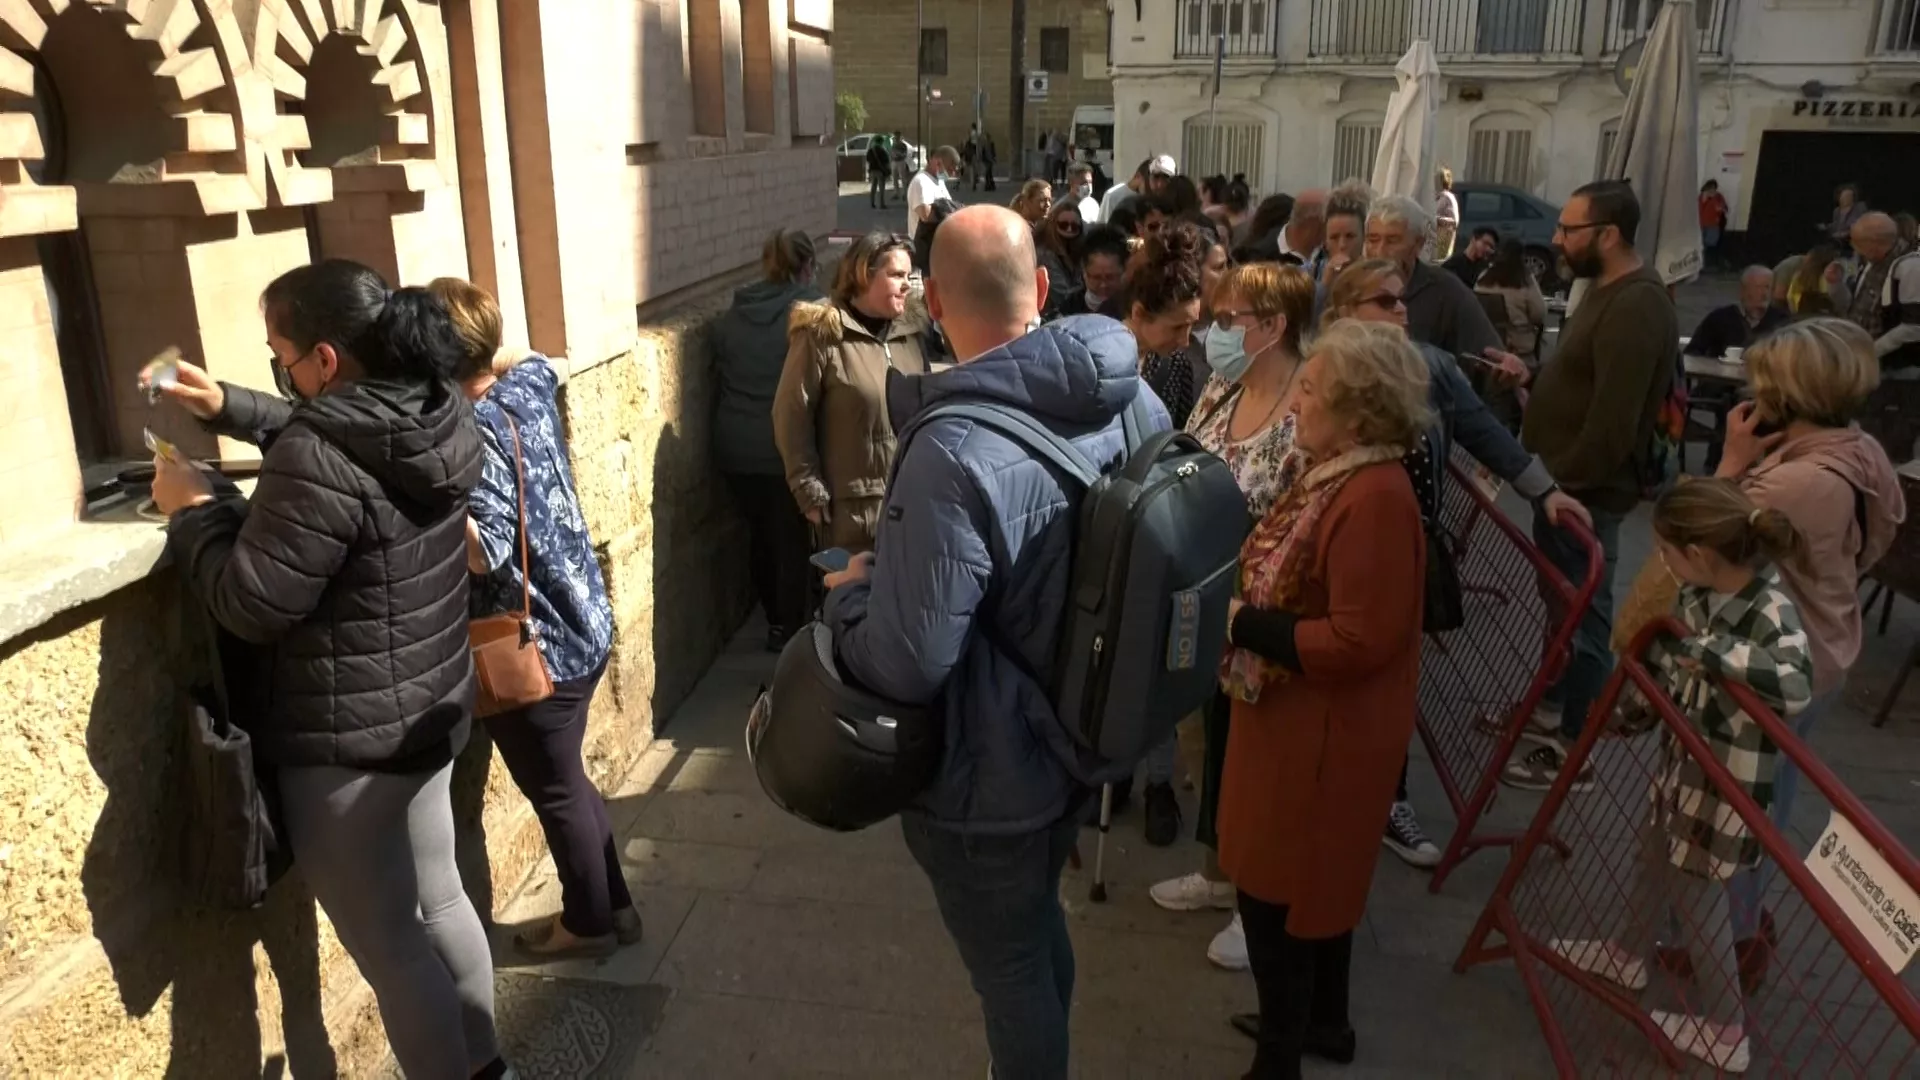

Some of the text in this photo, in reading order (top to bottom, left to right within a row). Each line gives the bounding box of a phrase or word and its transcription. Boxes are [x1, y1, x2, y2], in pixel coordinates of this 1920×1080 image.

[1836, 845, 1885, 904] Ayuntamiento
[1881, 899, 1896, 917] de
[1893, 908, 1920, 944] Cádiz
